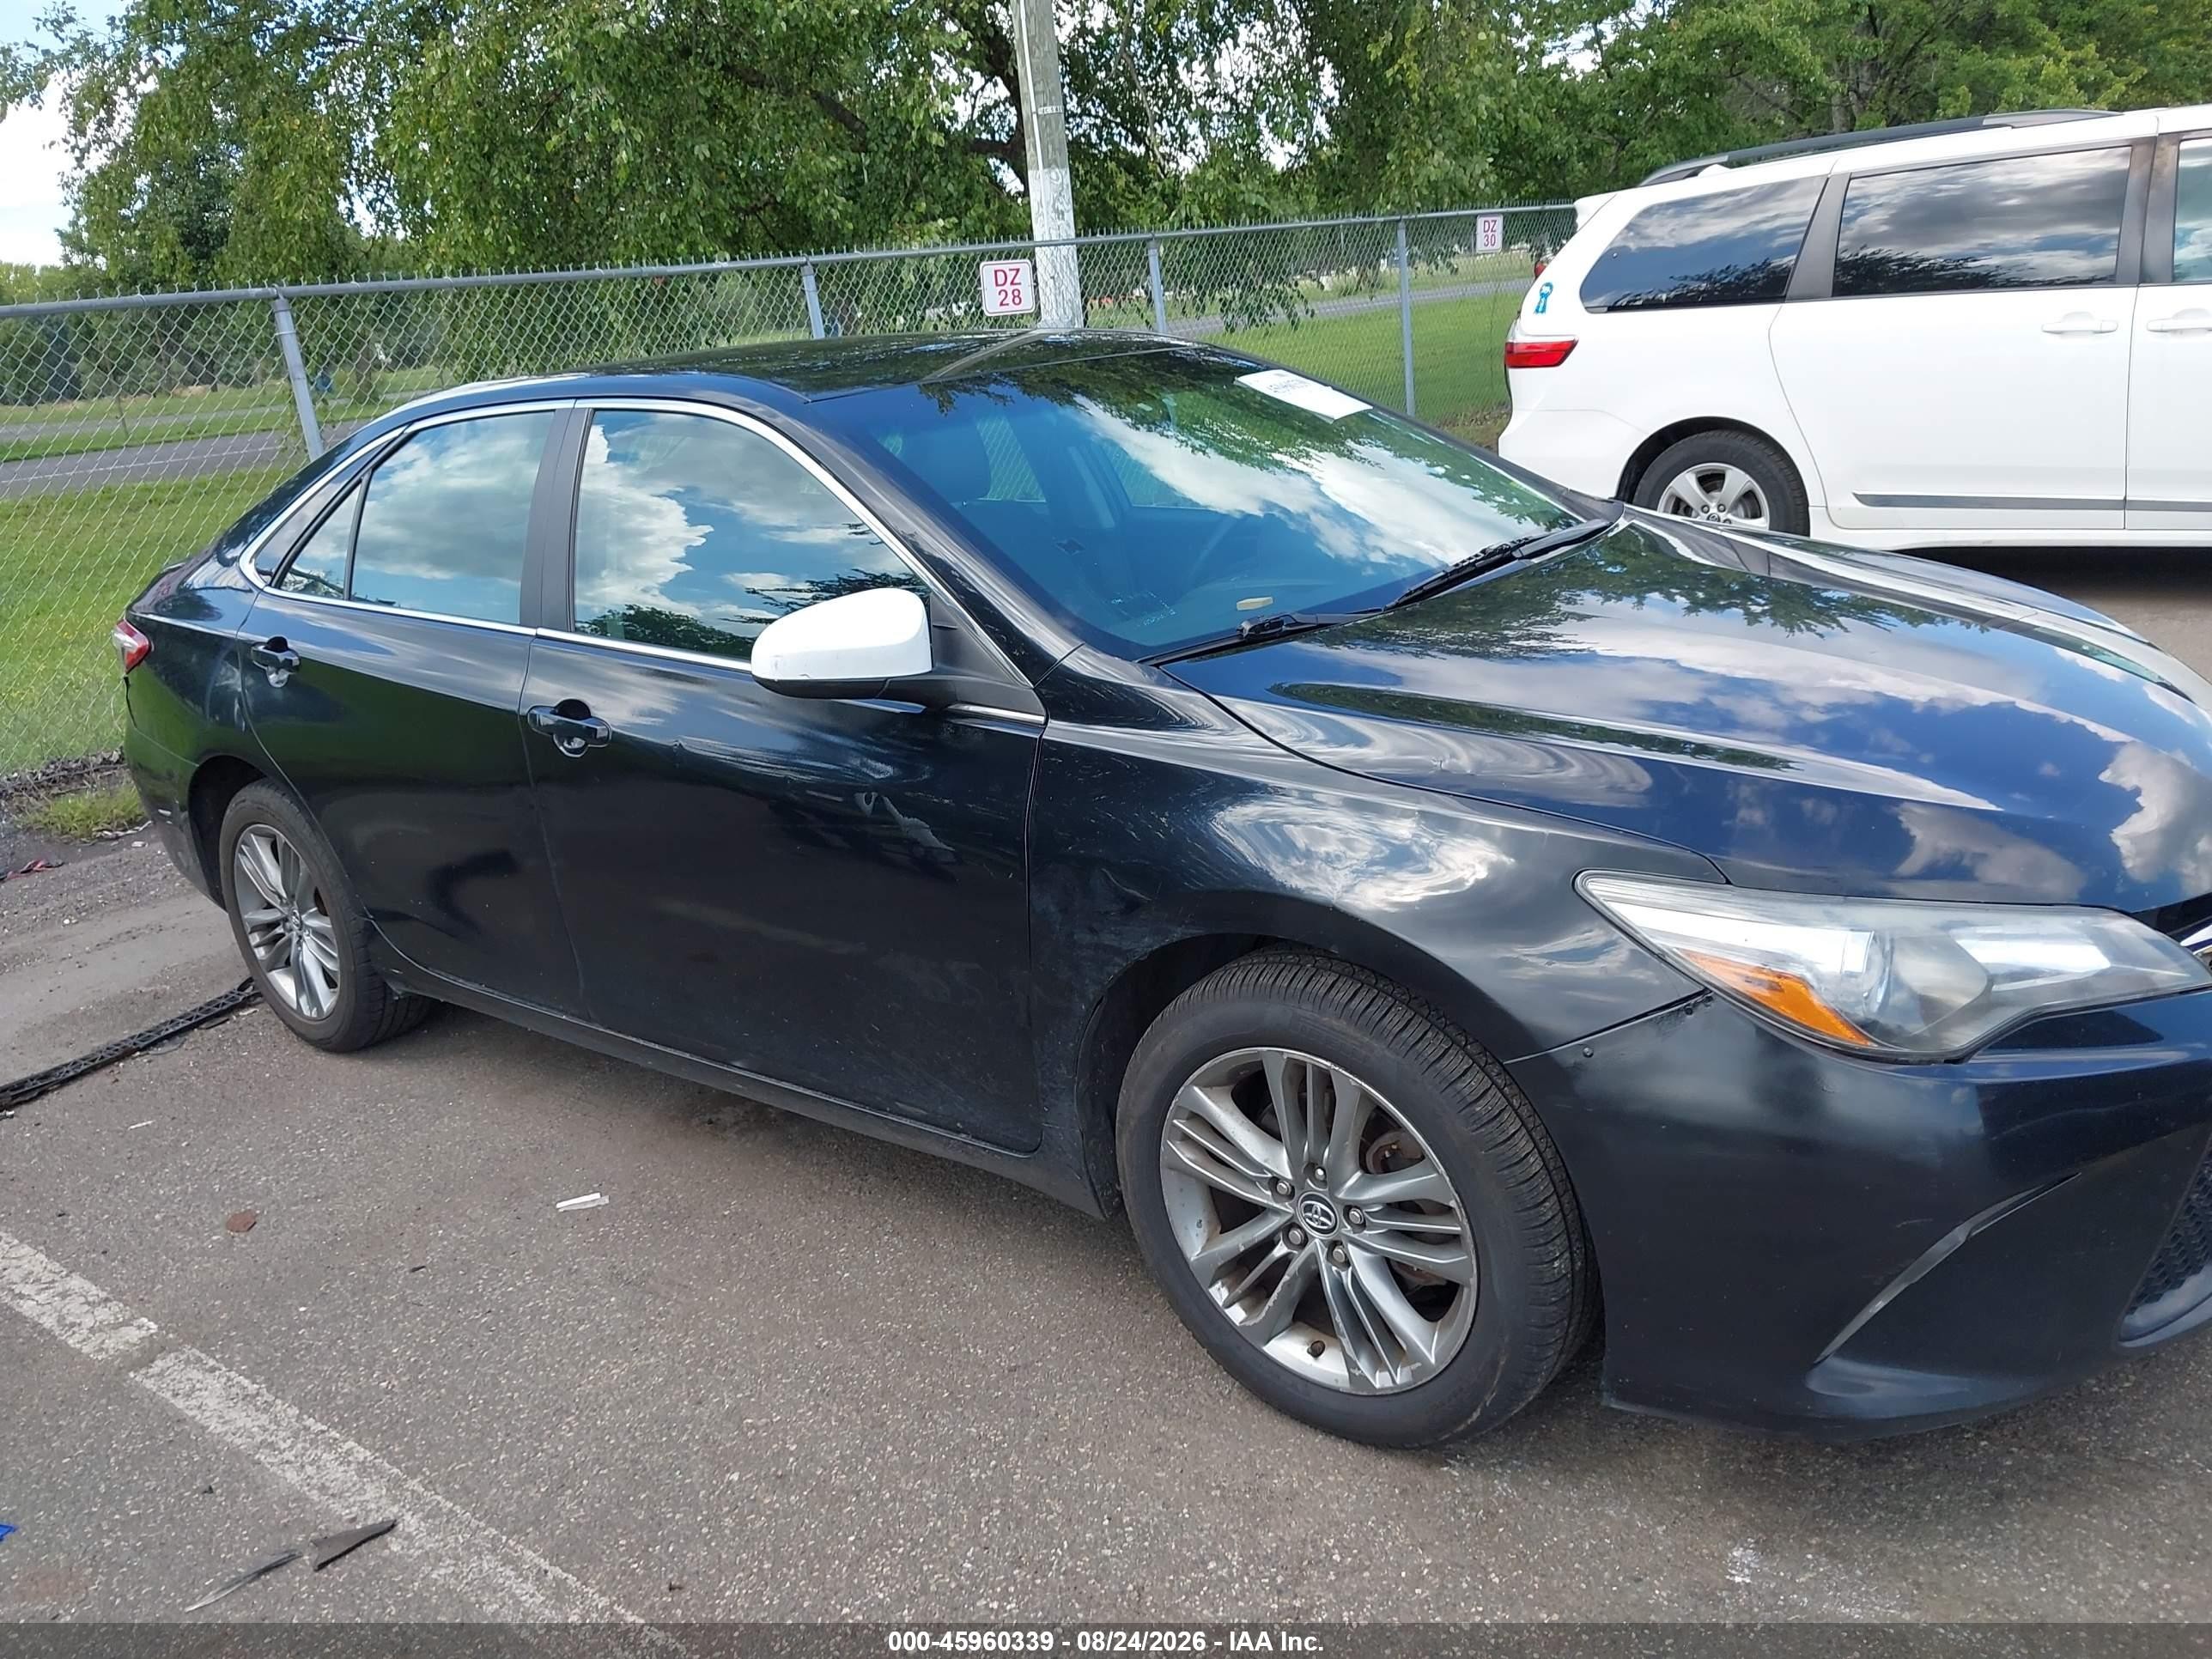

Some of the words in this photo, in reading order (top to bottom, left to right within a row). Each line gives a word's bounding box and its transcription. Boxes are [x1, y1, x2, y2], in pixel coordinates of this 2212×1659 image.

[1483, 219, 1498, 233] DZ
[1483, 234, 1497, 247] 30
[994, 268, 1022, 288] DZ
[998, 288, 1023, 307] 28
